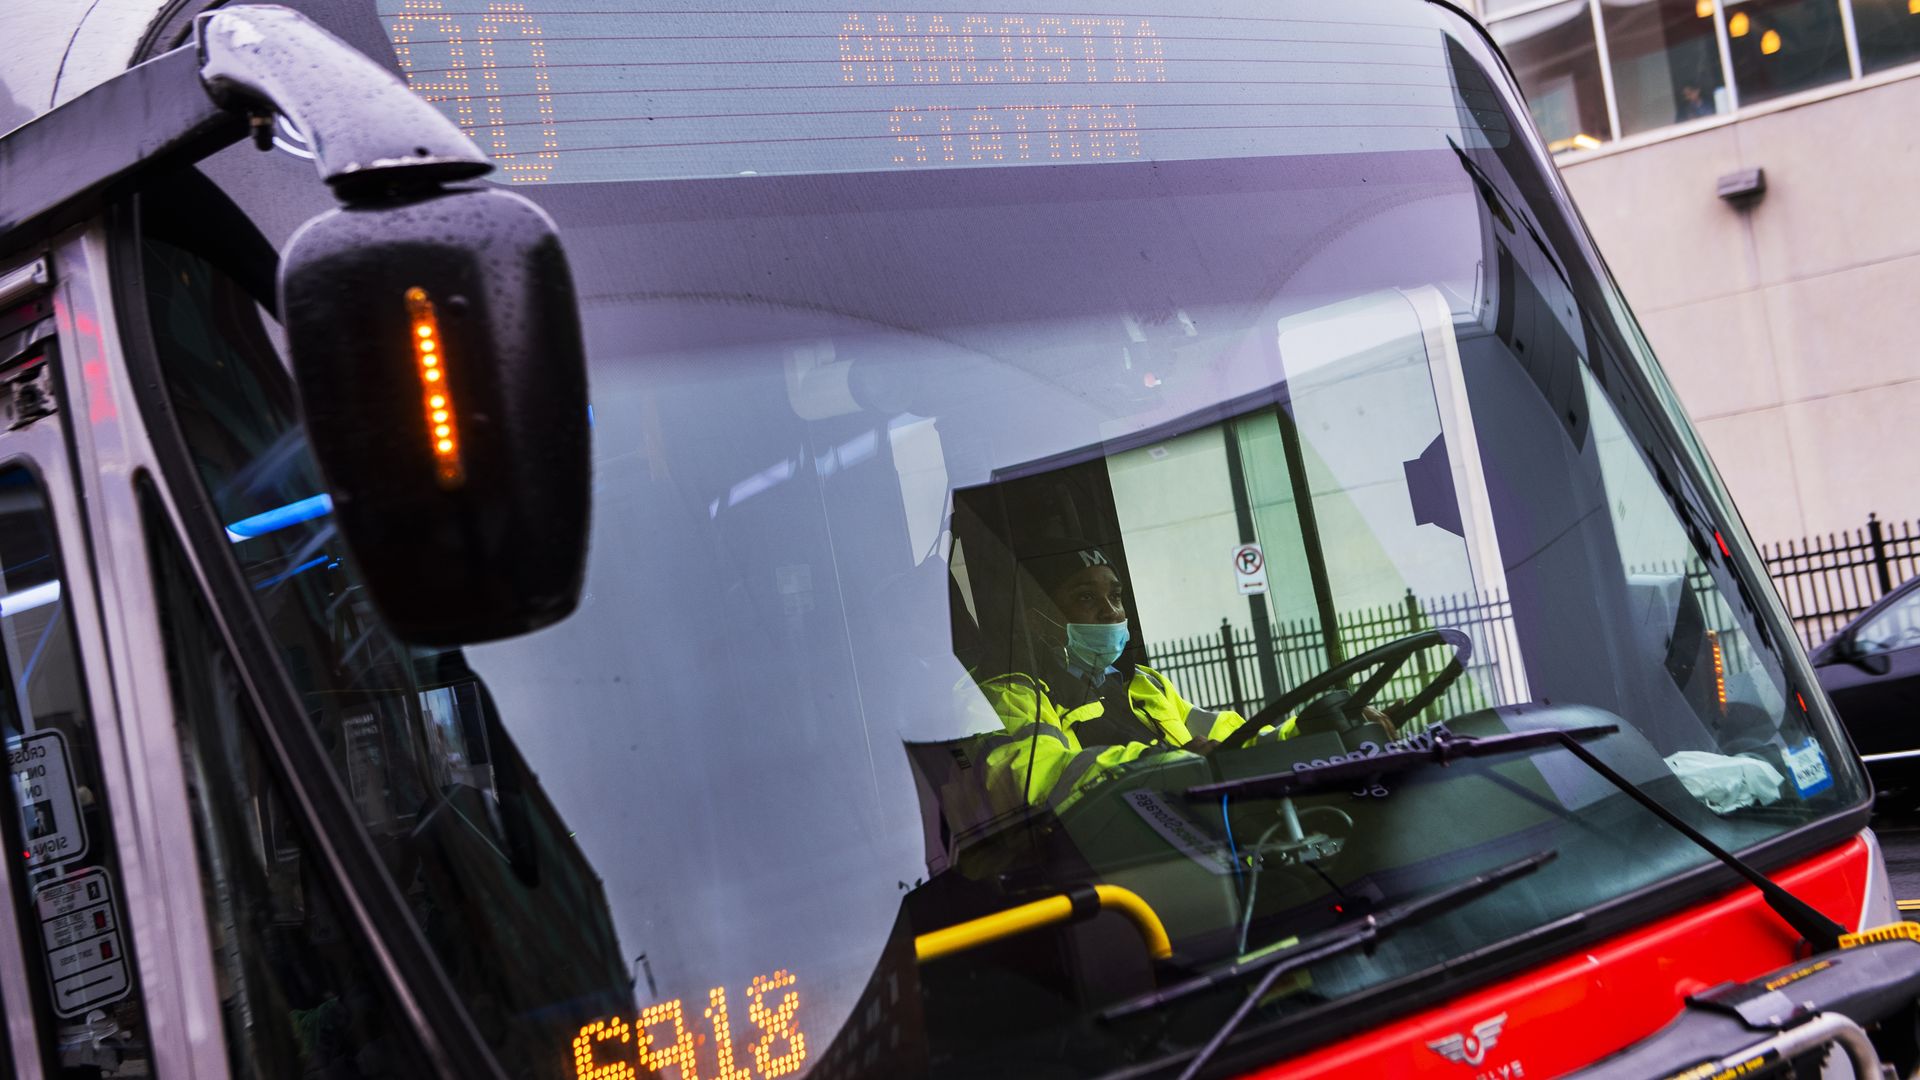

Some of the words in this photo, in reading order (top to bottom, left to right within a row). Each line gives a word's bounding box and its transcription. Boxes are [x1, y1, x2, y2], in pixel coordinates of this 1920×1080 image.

[838, 12, 1167, 83] ANACOSTIA
[889, 103, 1141, 162] STATION
[1078, 550, 1107, 568] M
